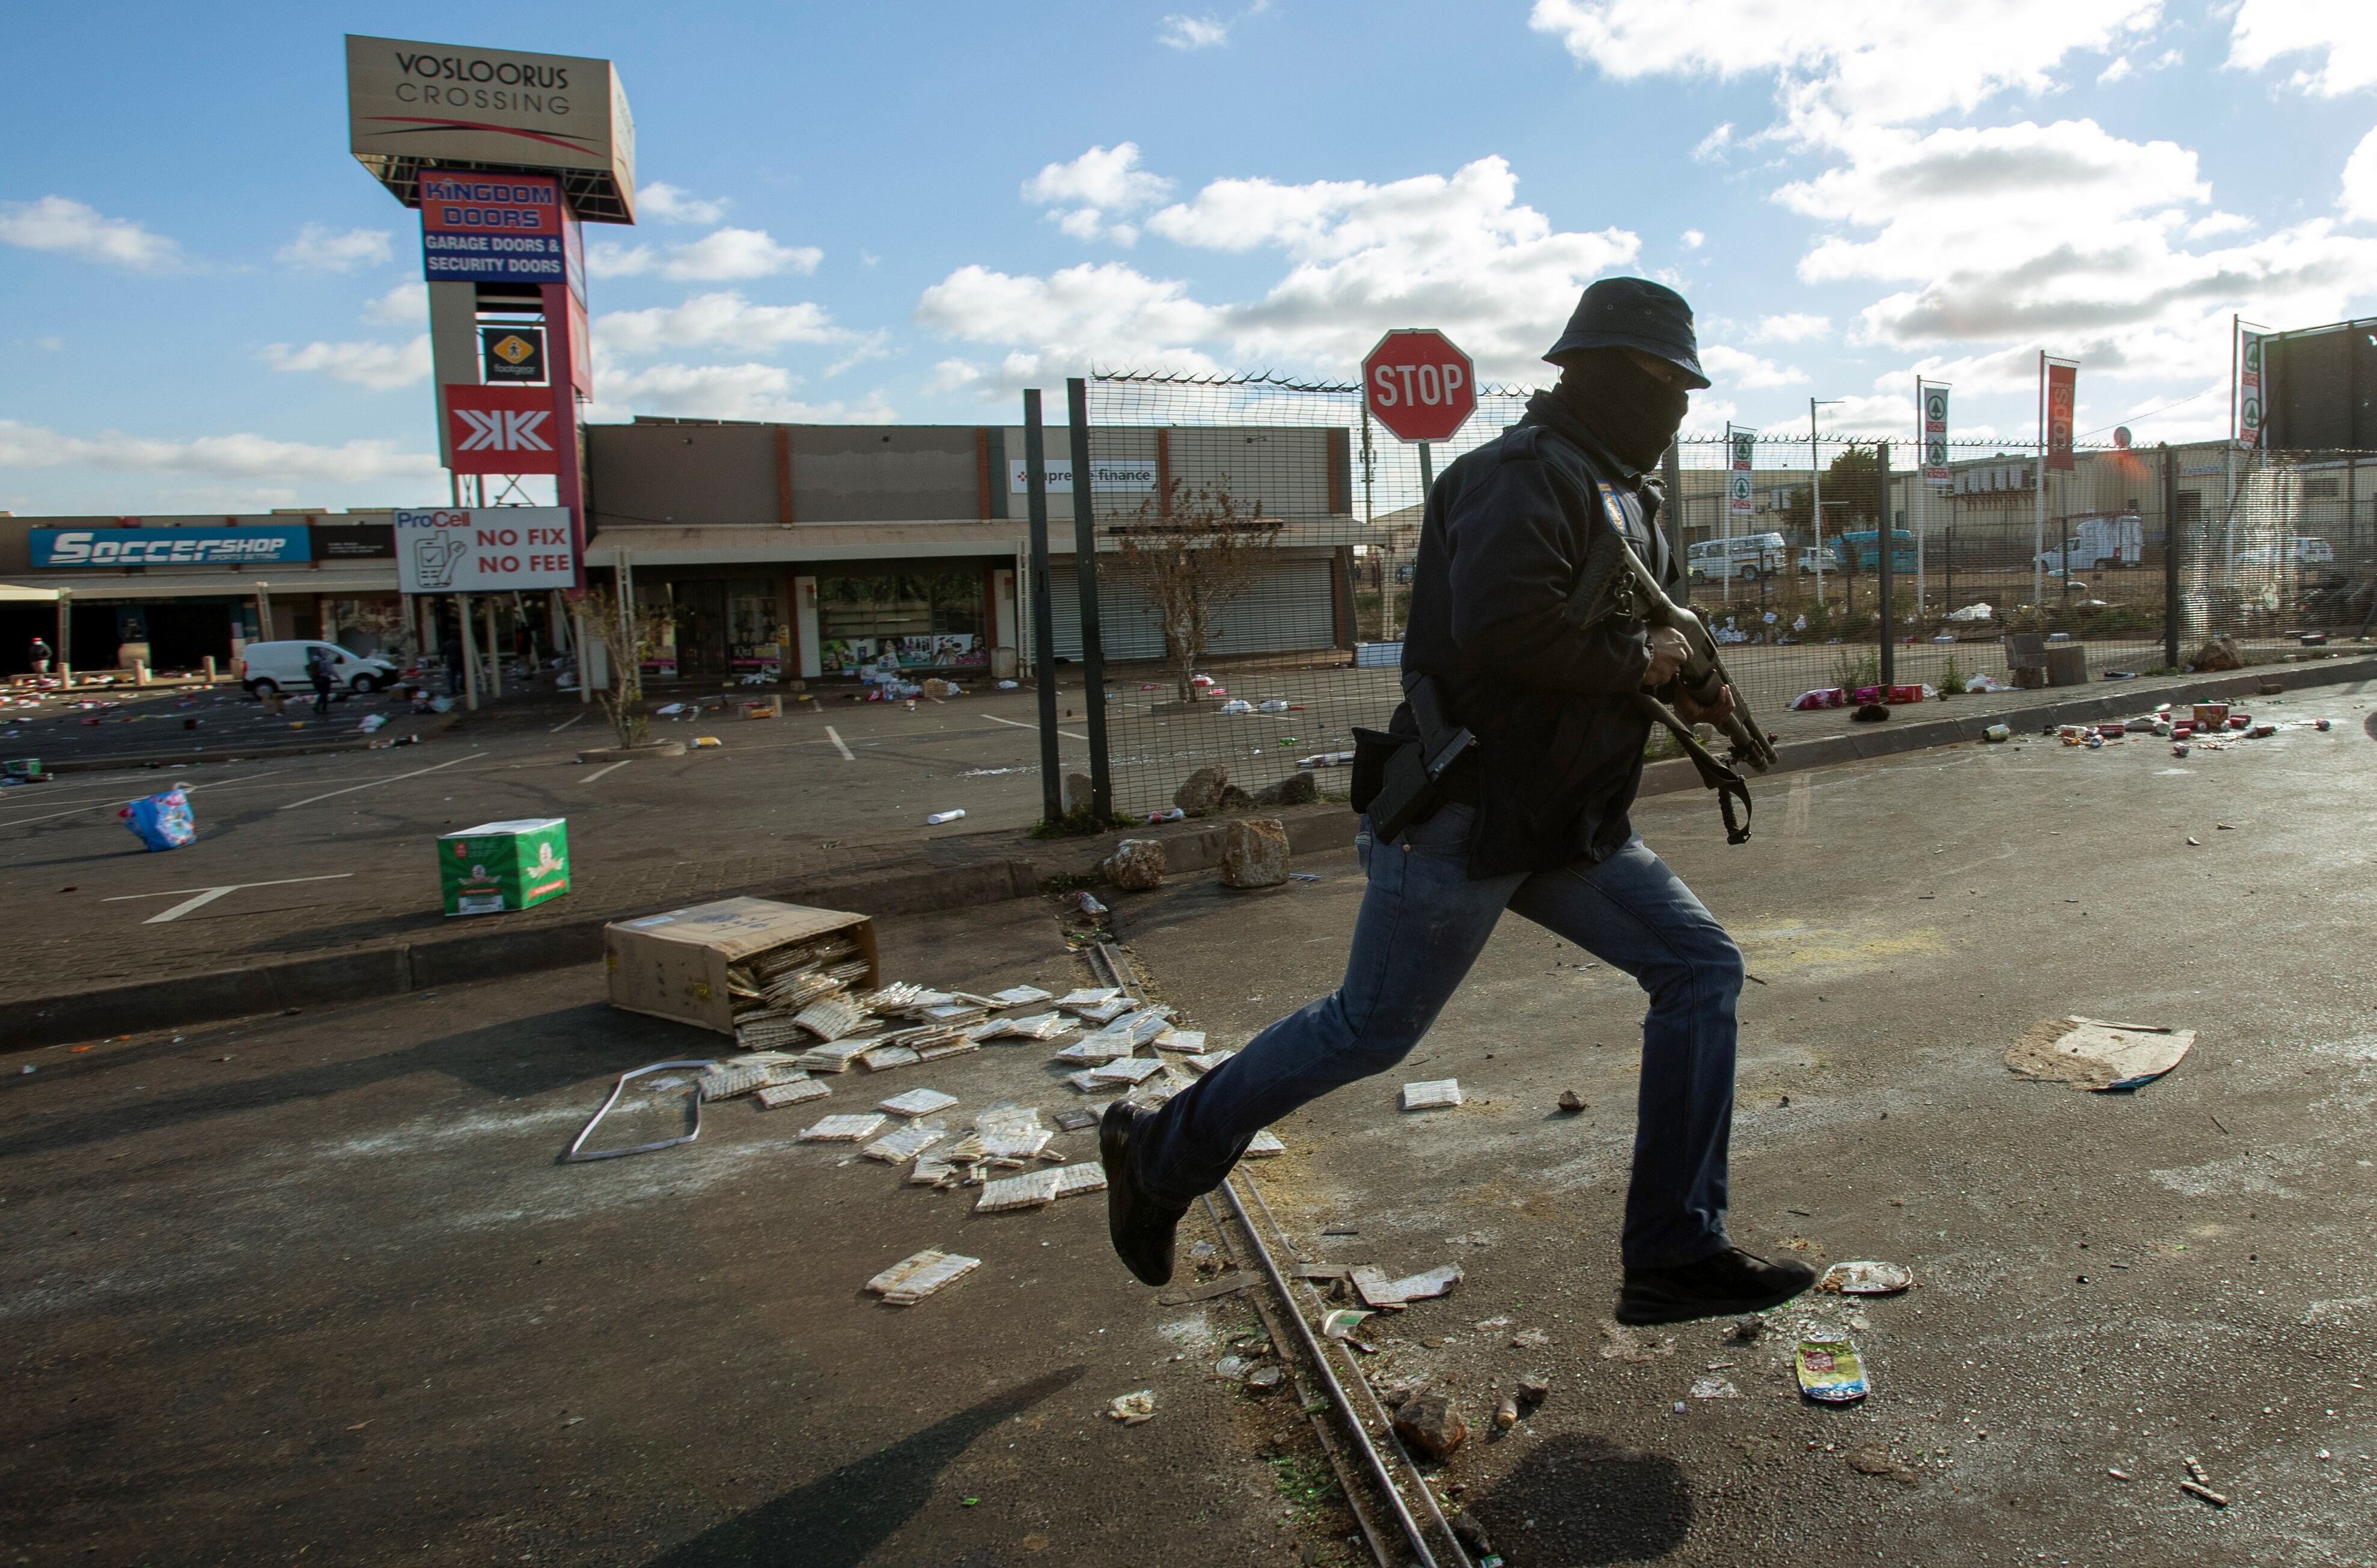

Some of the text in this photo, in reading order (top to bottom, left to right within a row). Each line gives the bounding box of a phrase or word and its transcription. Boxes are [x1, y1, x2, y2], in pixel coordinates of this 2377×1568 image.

[395, 52, 569, 90] VOSLOORUS
[396, 83, 570, 115] CROSSING
[442, 206, 541, 229] DOORS
[426, 235, 561, 253] GARAGE DOORS &
[429, 257, 561, 273] SECURITY DOORS
[1375, 364, 1463, 406] STOP
[1099, 468, 1150, 480] finance
[397, 511, 471, 528] ProCell
[477, 528, 567, 546] NO FIX
[478, 554, 570, 573] NO FEE
